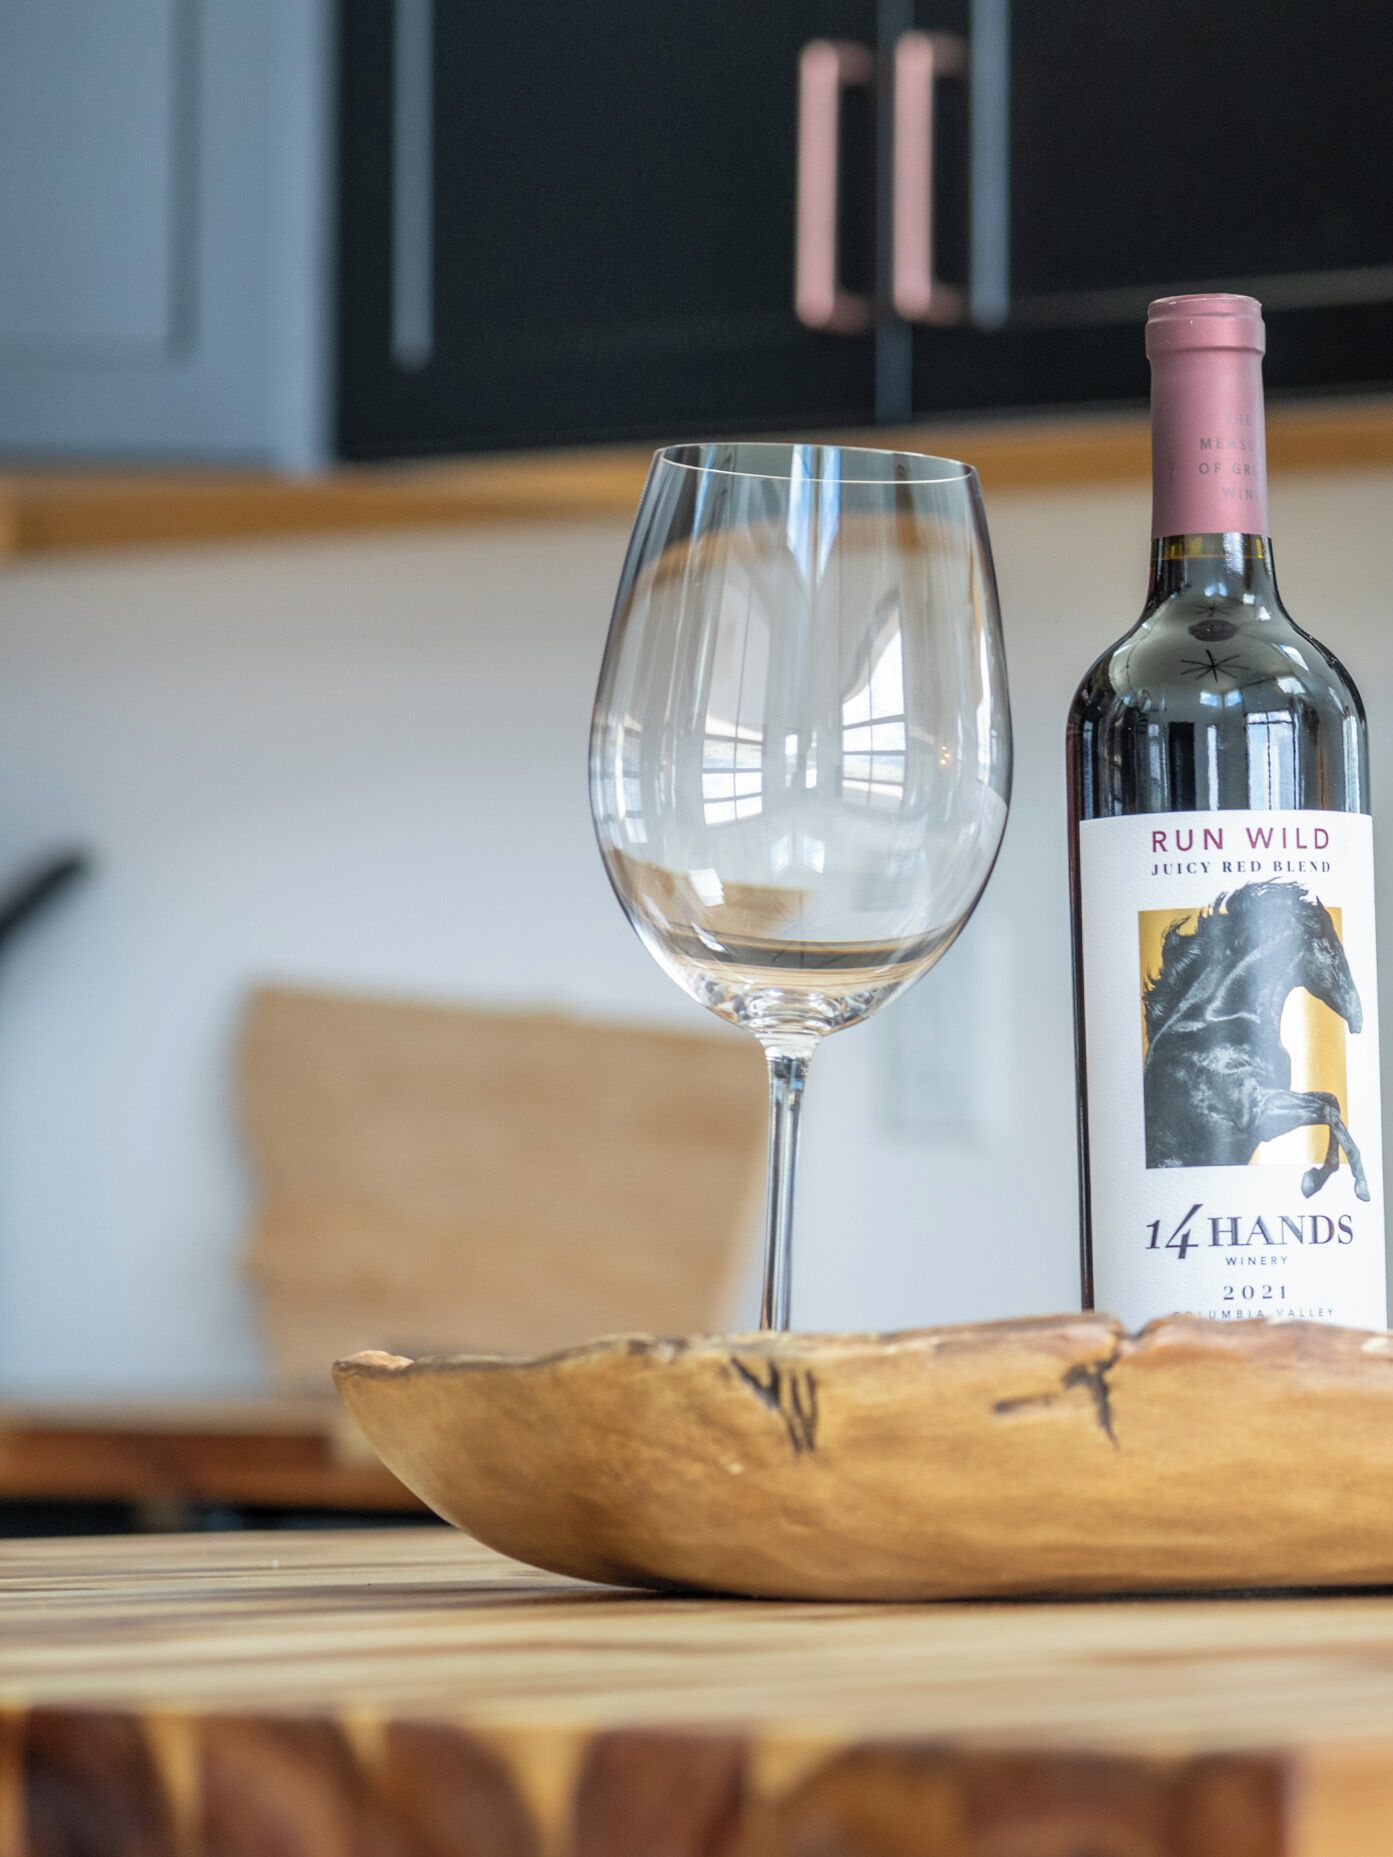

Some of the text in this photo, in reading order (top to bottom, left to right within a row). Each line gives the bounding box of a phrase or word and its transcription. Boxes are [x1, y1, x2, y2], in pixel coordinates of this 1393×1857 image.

[1199, 463, 1221, 475] OF
[1151, 827, 1330, 852] RUN WILD
[1151, 860, 1331, 876] JUICY RED BLEND
[1145, 1203, 1354, 1260] 14 HANDS
[1225, 1256, 1289, 1266] WINERY
[1223, 1285, 1287, 1300] 2021
[1276, 1308, 1334, 1318] VALLEY
